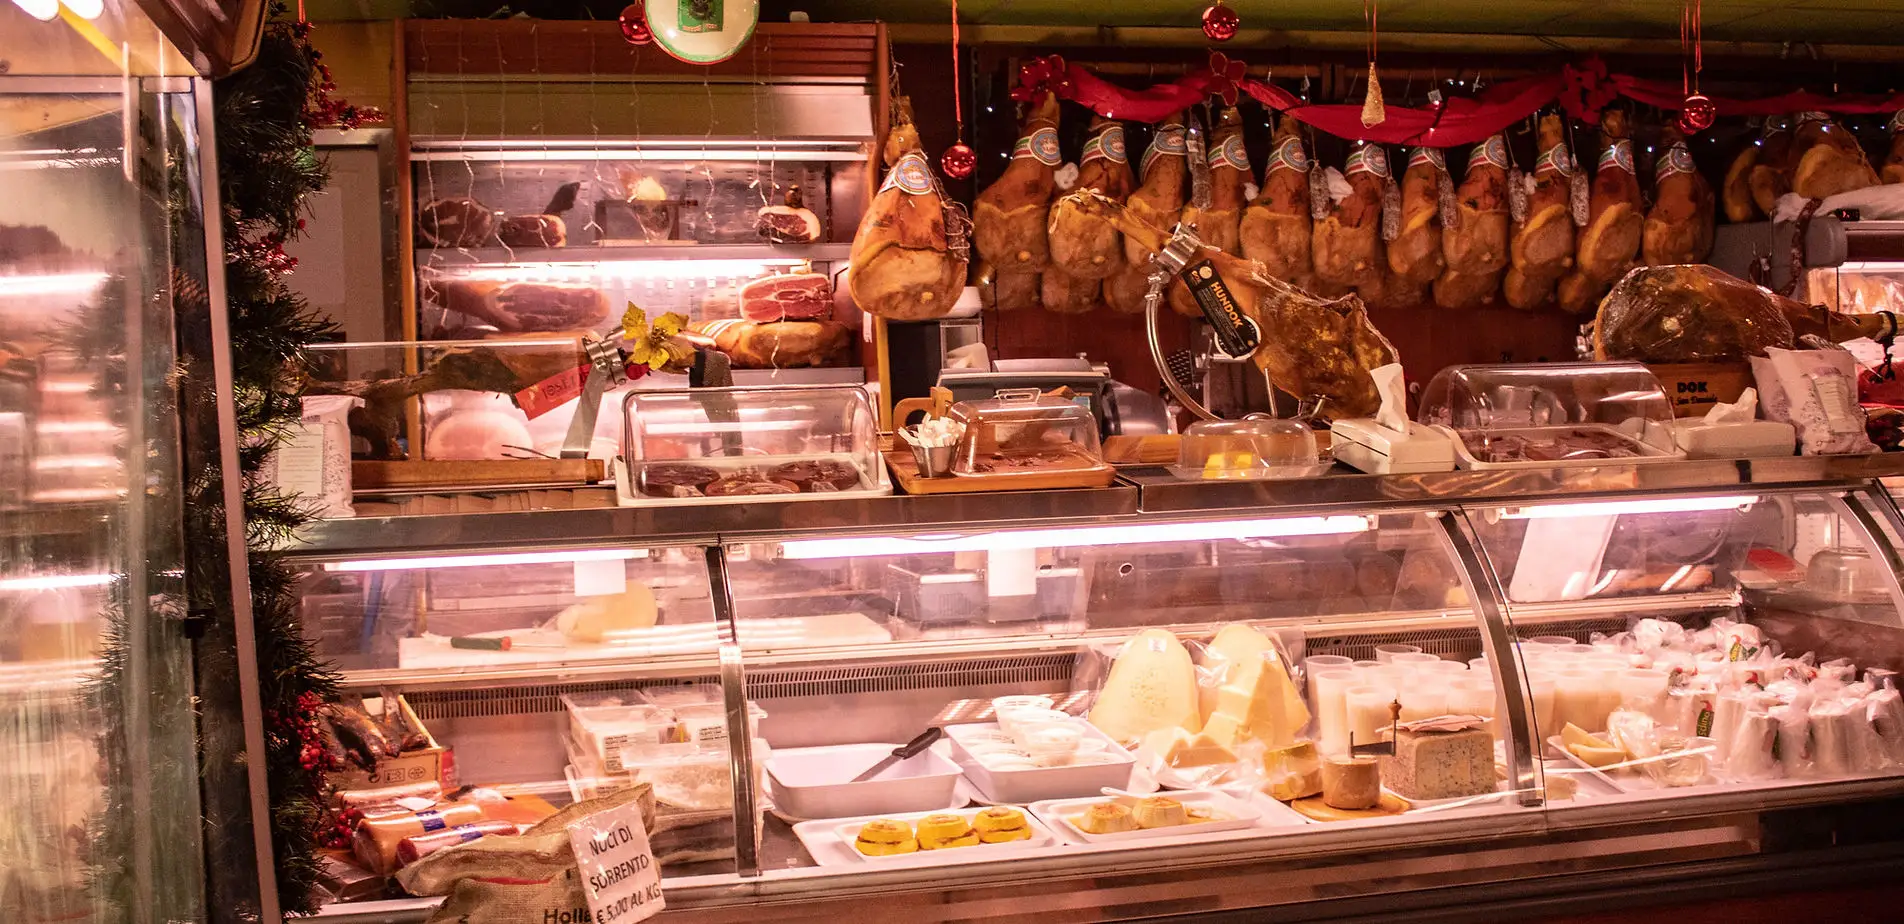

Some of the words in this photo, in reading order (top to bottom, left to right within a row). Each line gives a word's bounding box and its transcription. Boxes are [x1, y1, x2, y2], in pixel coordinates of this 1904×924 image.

[1210, 281, 1244, 328] HUNDOK
[1677, 382, 1708, 393] DOK
[618, 825, 634, 843] DI
[589, 854, 649, 893] SORRENTO
[596, 909, 606, 924] €
[606, 896, 628, 921] 5,00
[630, 890, 643, 909] AL
[645, 882, 661, 901] KG
